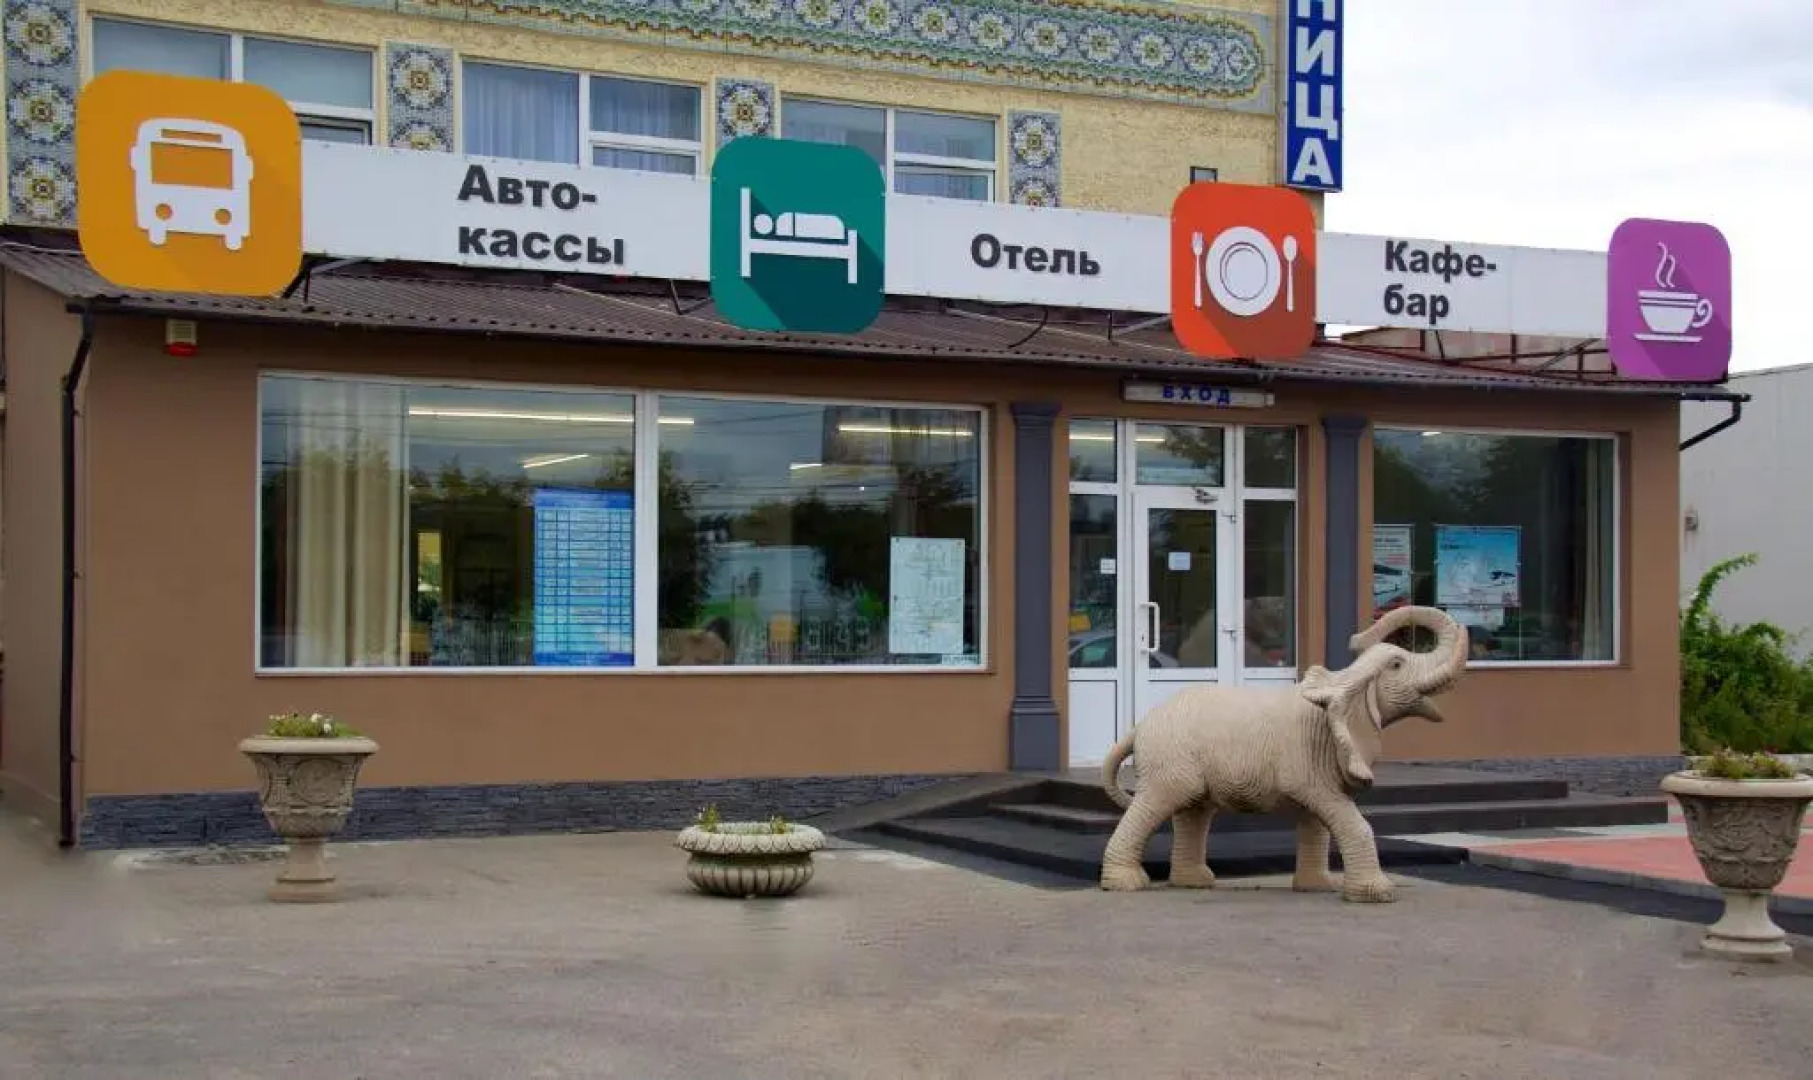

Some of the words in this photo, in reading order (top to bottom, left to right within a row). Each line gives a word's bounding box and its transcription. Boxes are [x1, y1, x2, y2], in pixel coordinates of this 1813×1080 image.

[457, 164, 598, 209] Авто-
[458, 226, 625, 265] кассы
[971, 233, 1100, 275] Отель
[1385, 240, 1497, 283] Кафе-
[1384, 283, 1450, 325] бар
[1162, 384, 1231, 405] ВХОД
